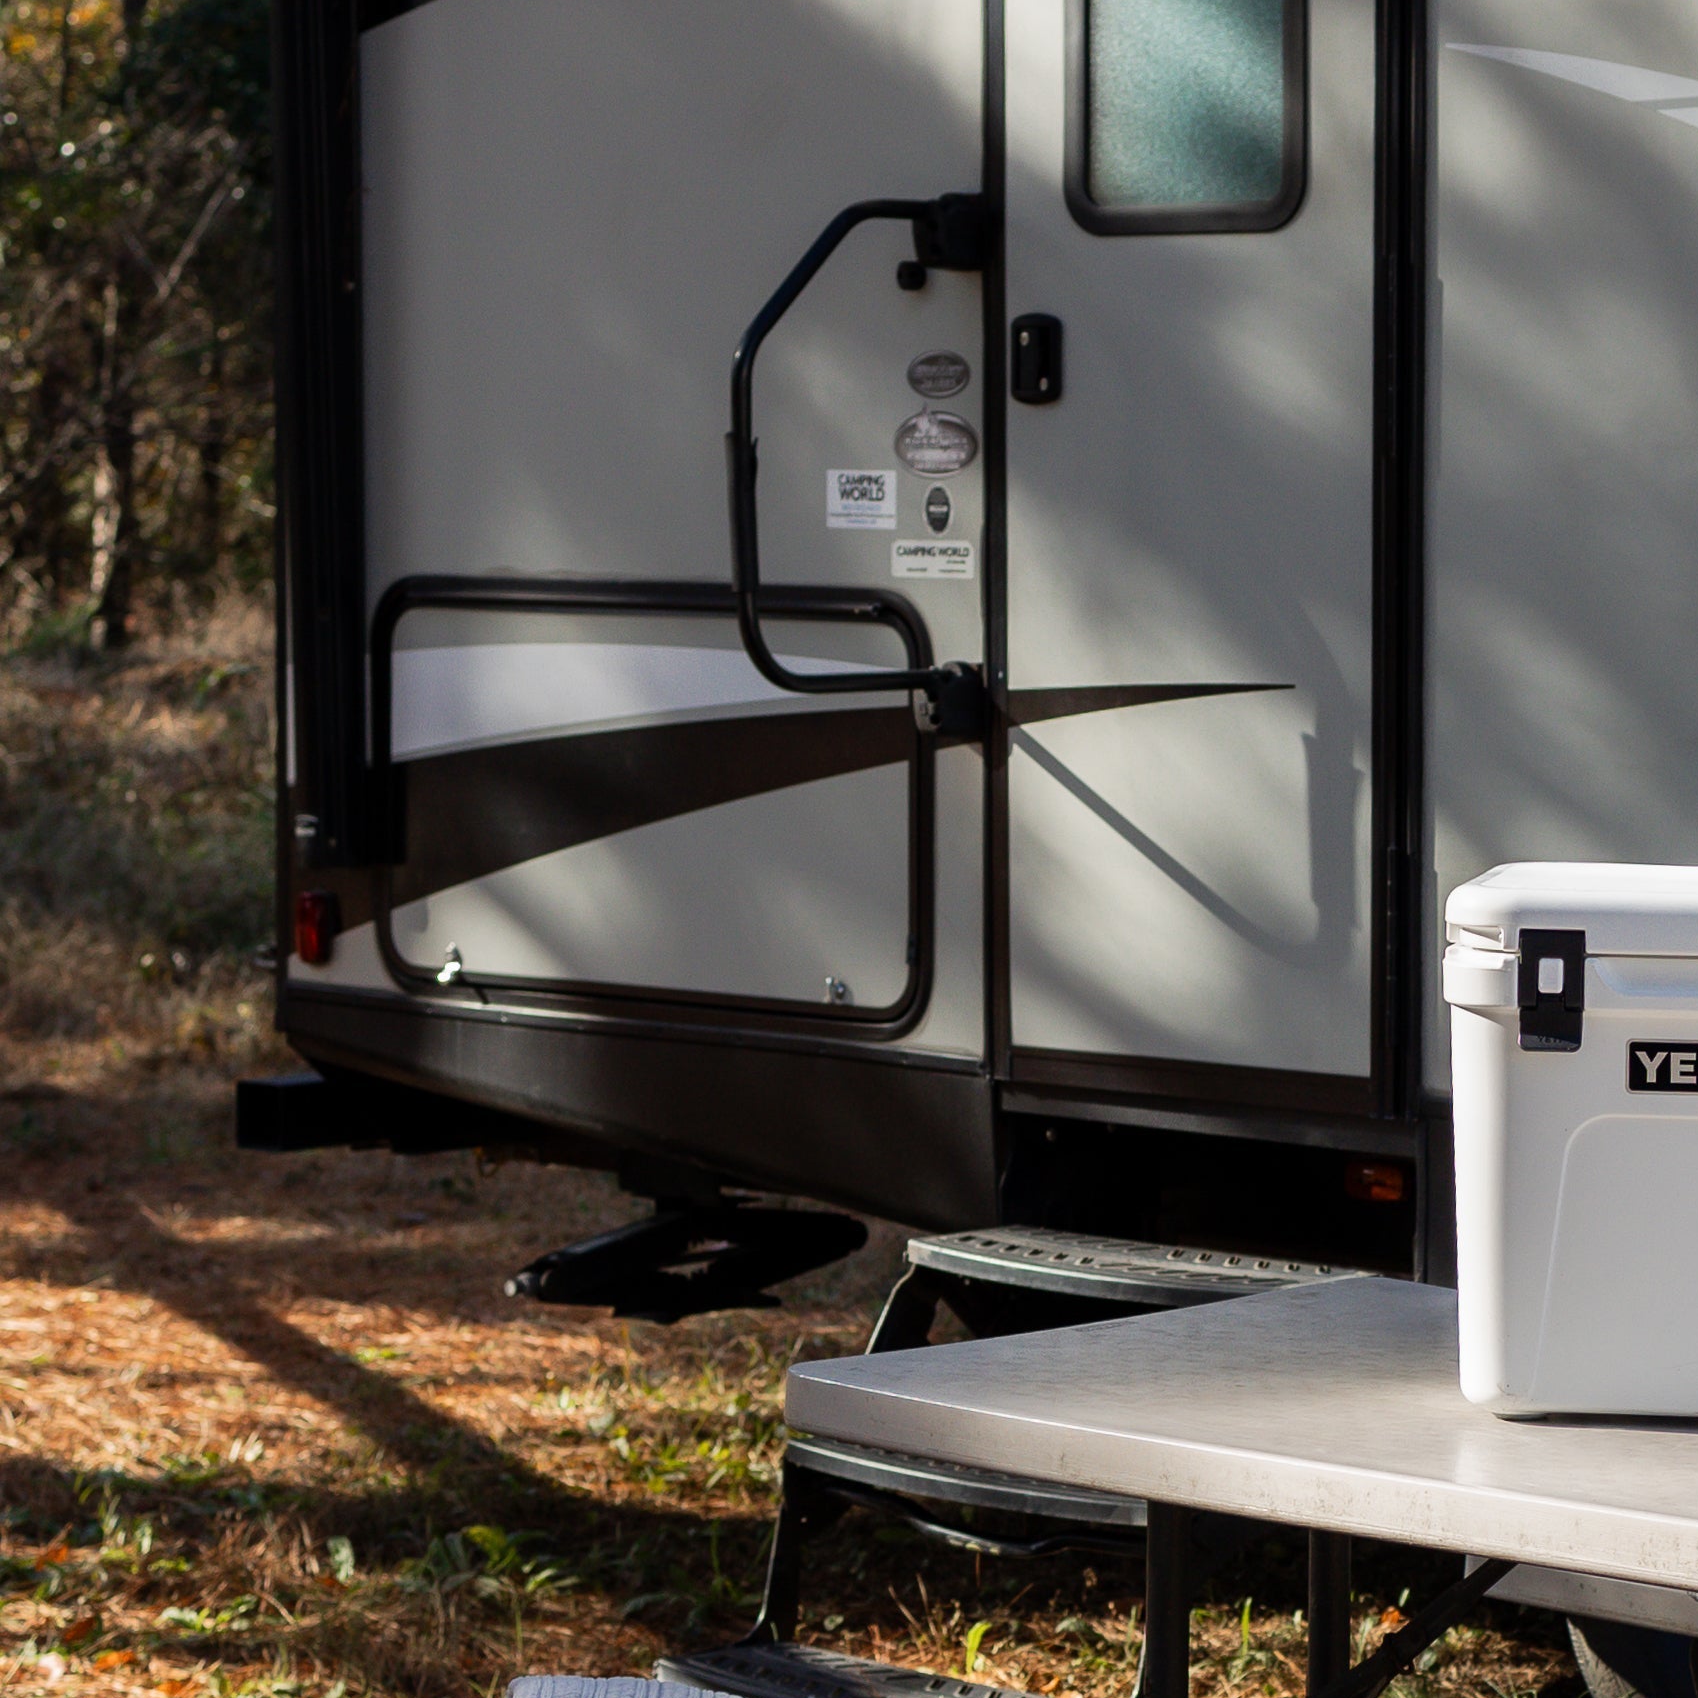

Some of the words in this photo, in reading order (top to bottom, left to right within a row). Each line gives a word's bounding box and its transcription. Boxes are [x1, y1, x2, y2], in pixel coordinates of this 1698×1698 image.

[838, 473, 885, 486] CAMPING
[839, 486, 885, 501] WORLD
[896, 545, 936, 557] CAMPING
[938, 546, 970, 557] WORLD
